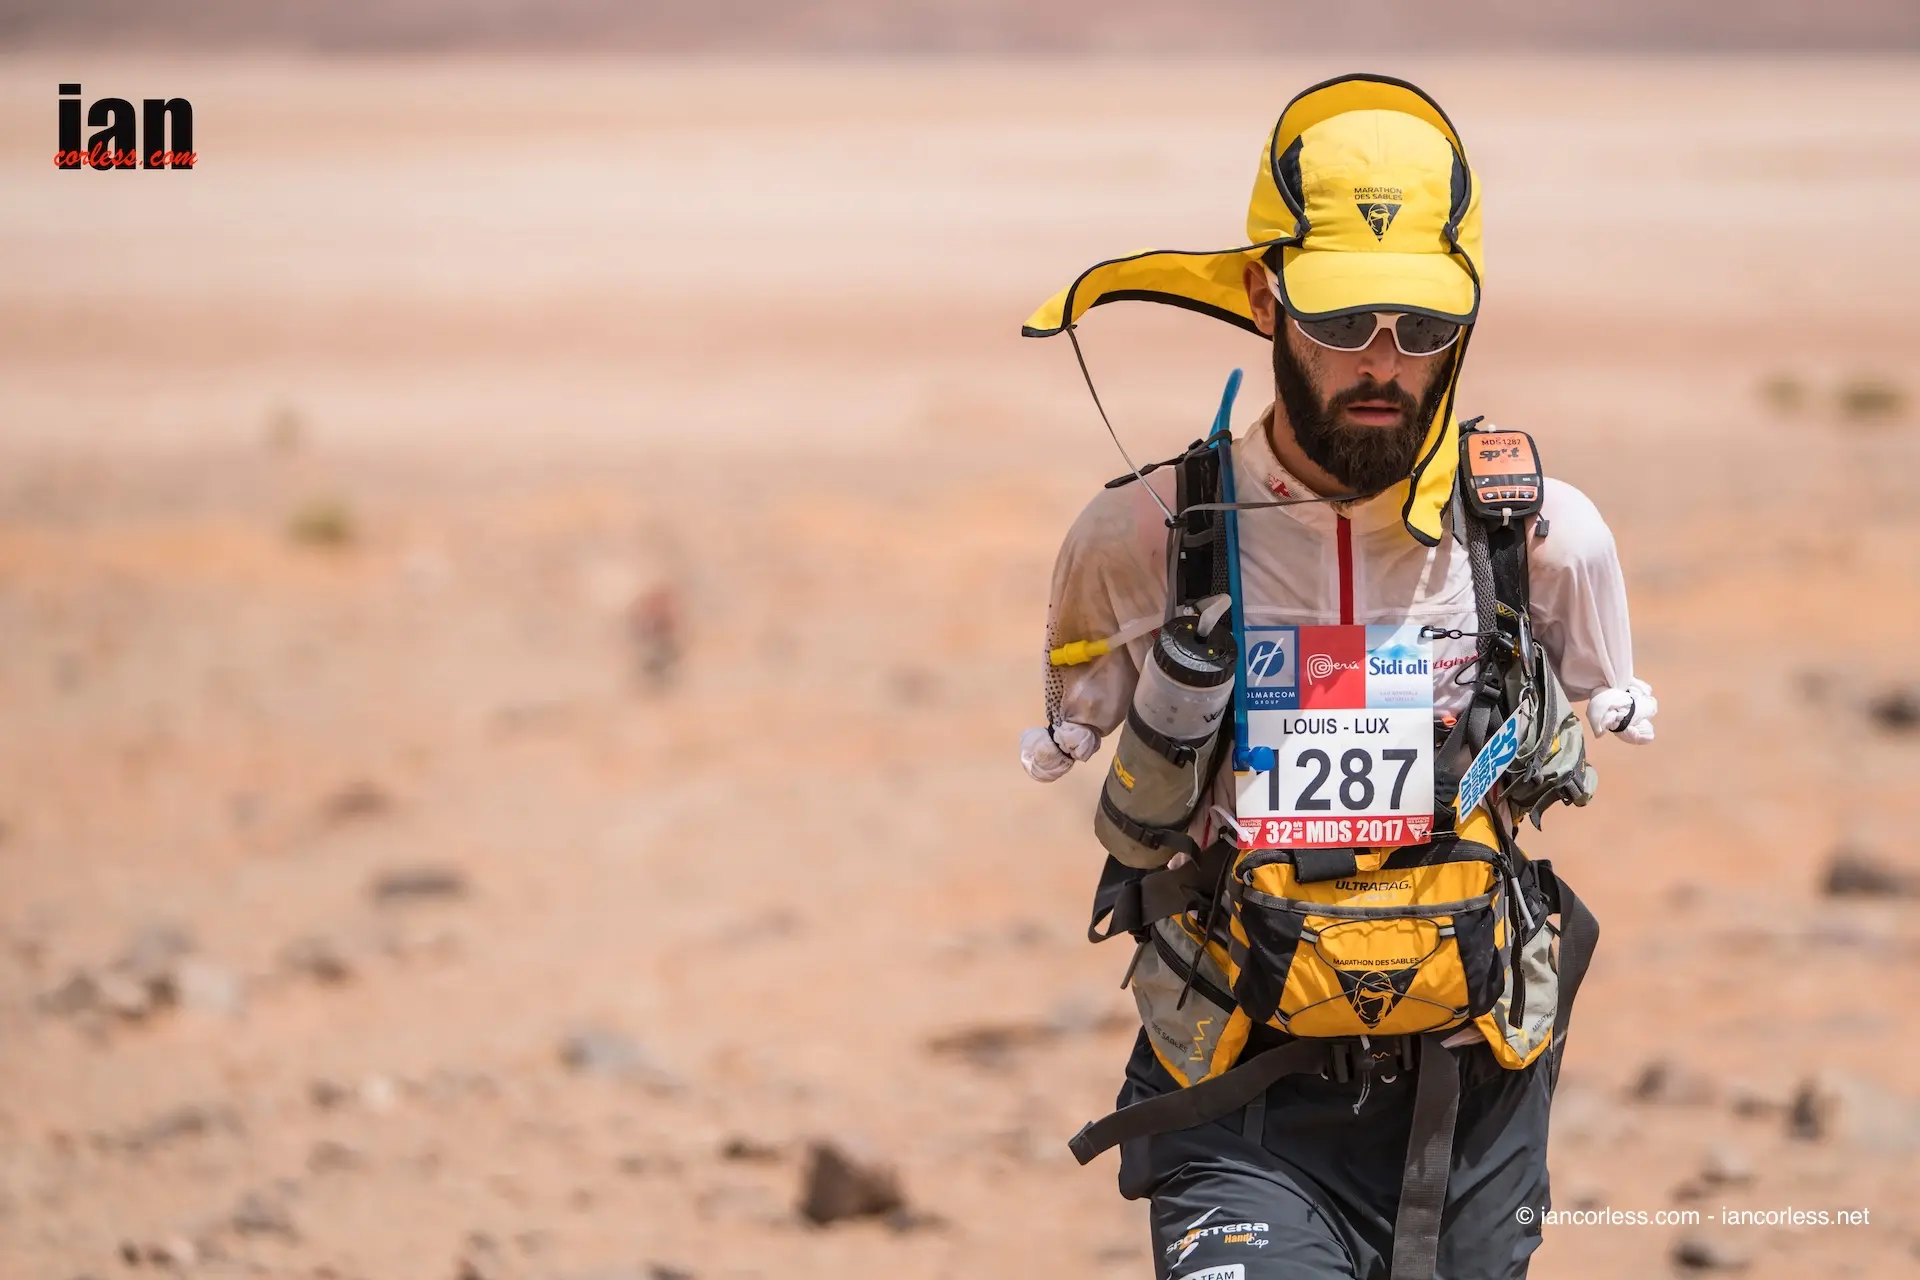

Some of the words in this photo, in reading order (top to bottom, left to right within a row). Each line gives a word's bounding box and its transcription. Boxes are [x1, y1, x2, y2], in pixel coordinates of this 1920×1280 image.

[1372, 193, 1403, 201] SABLES
[1368, 656, 1402, 676] Sidi
[1405, 659, 1428, 676] ali
[1246, 691, 1296, 699] LMARCOM
[1283, 718, 1337, 735] LOUIS
[1355, 717, 1390, 734] LUX
[1256, 748, 1418, 811] 1287
[1265, 820, 1293, 844] 32
[1306, 820, 1352, 843] MDS
[1356, 820, 1403, 842] 2017
[1333, 958, 1373, 966] MARATHON
